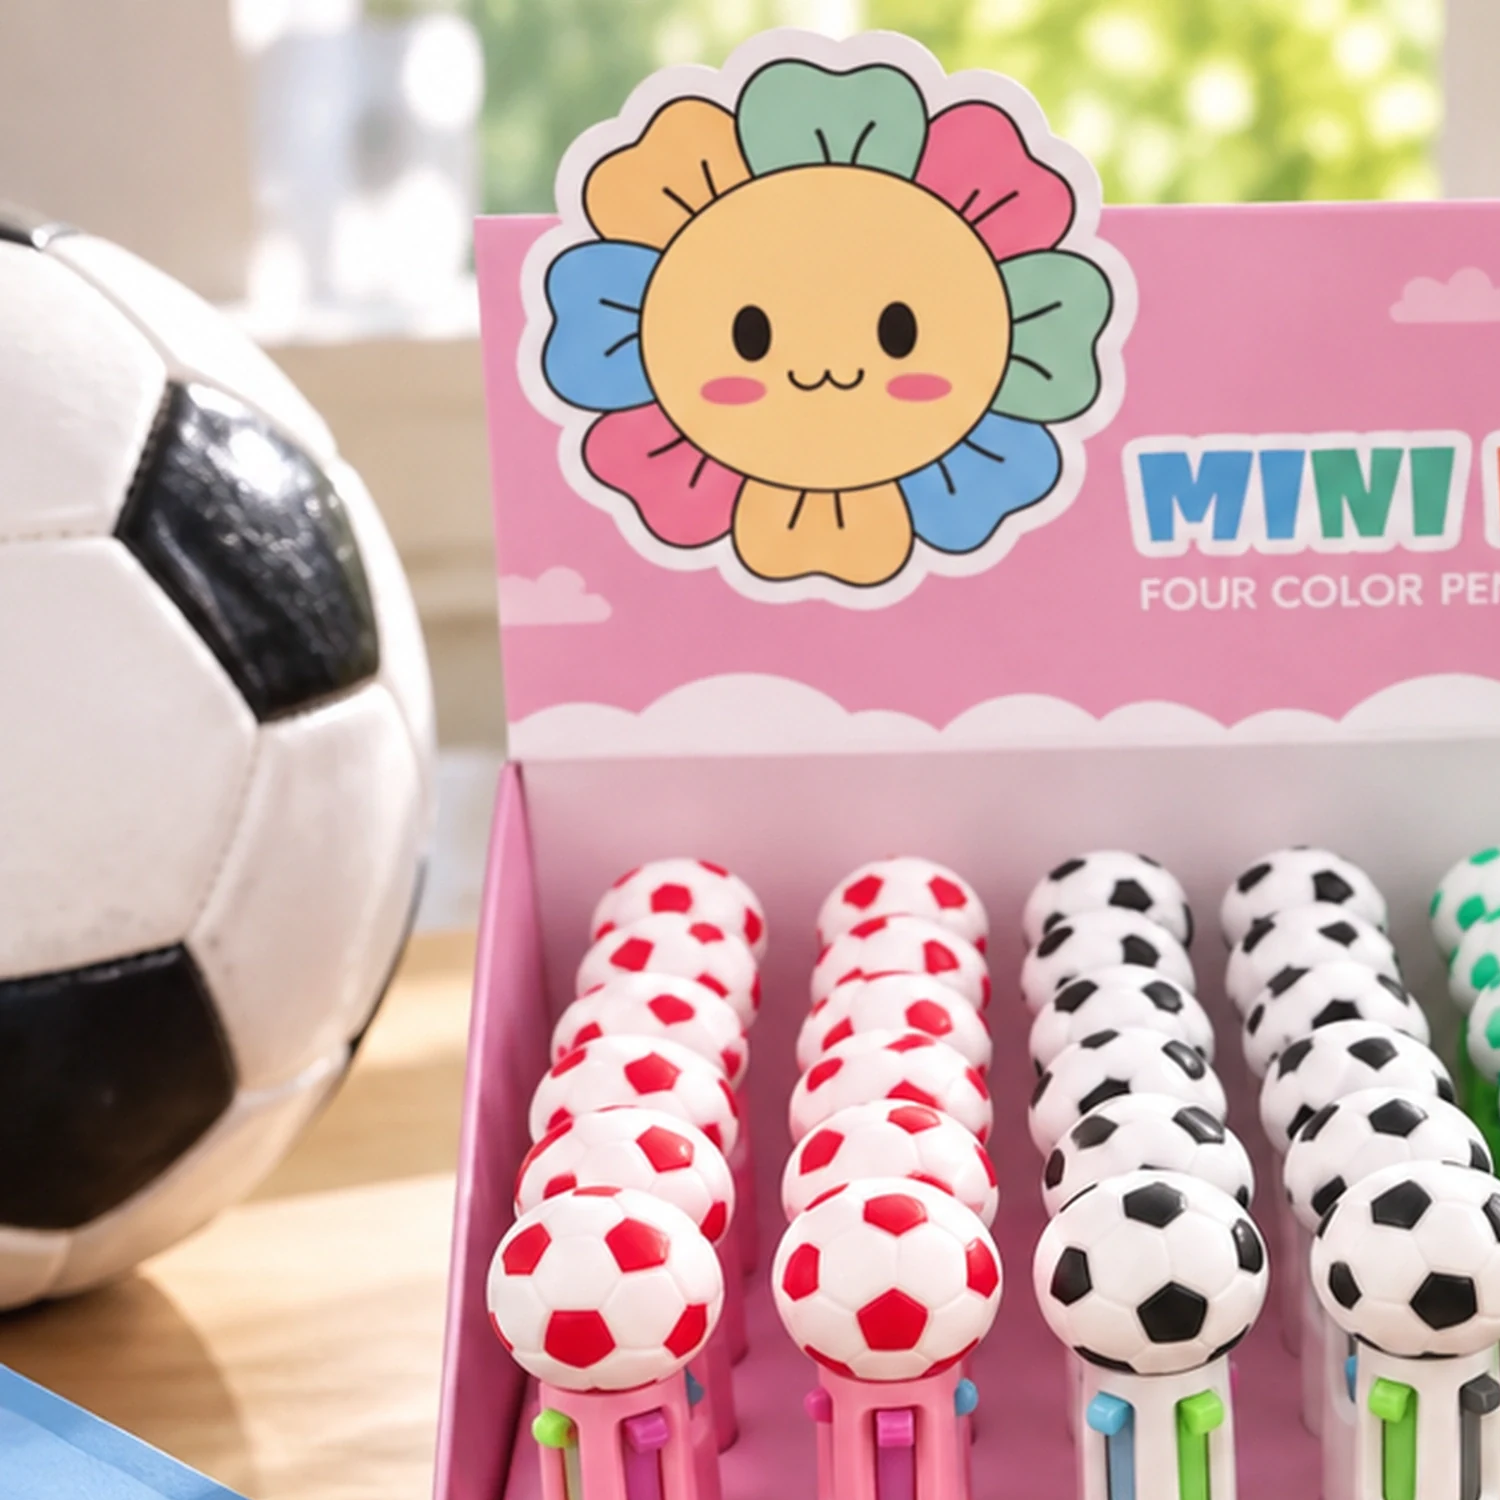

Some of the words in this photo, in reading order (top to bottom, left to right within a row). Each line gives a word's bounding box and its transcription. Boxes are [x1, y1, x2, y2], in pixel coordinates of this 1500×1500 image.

[1137, 447, 1455, 541] MINI
[1140, 575, 1257, 611] FOUR
[1271, 573, 1424, 609] COLOR
